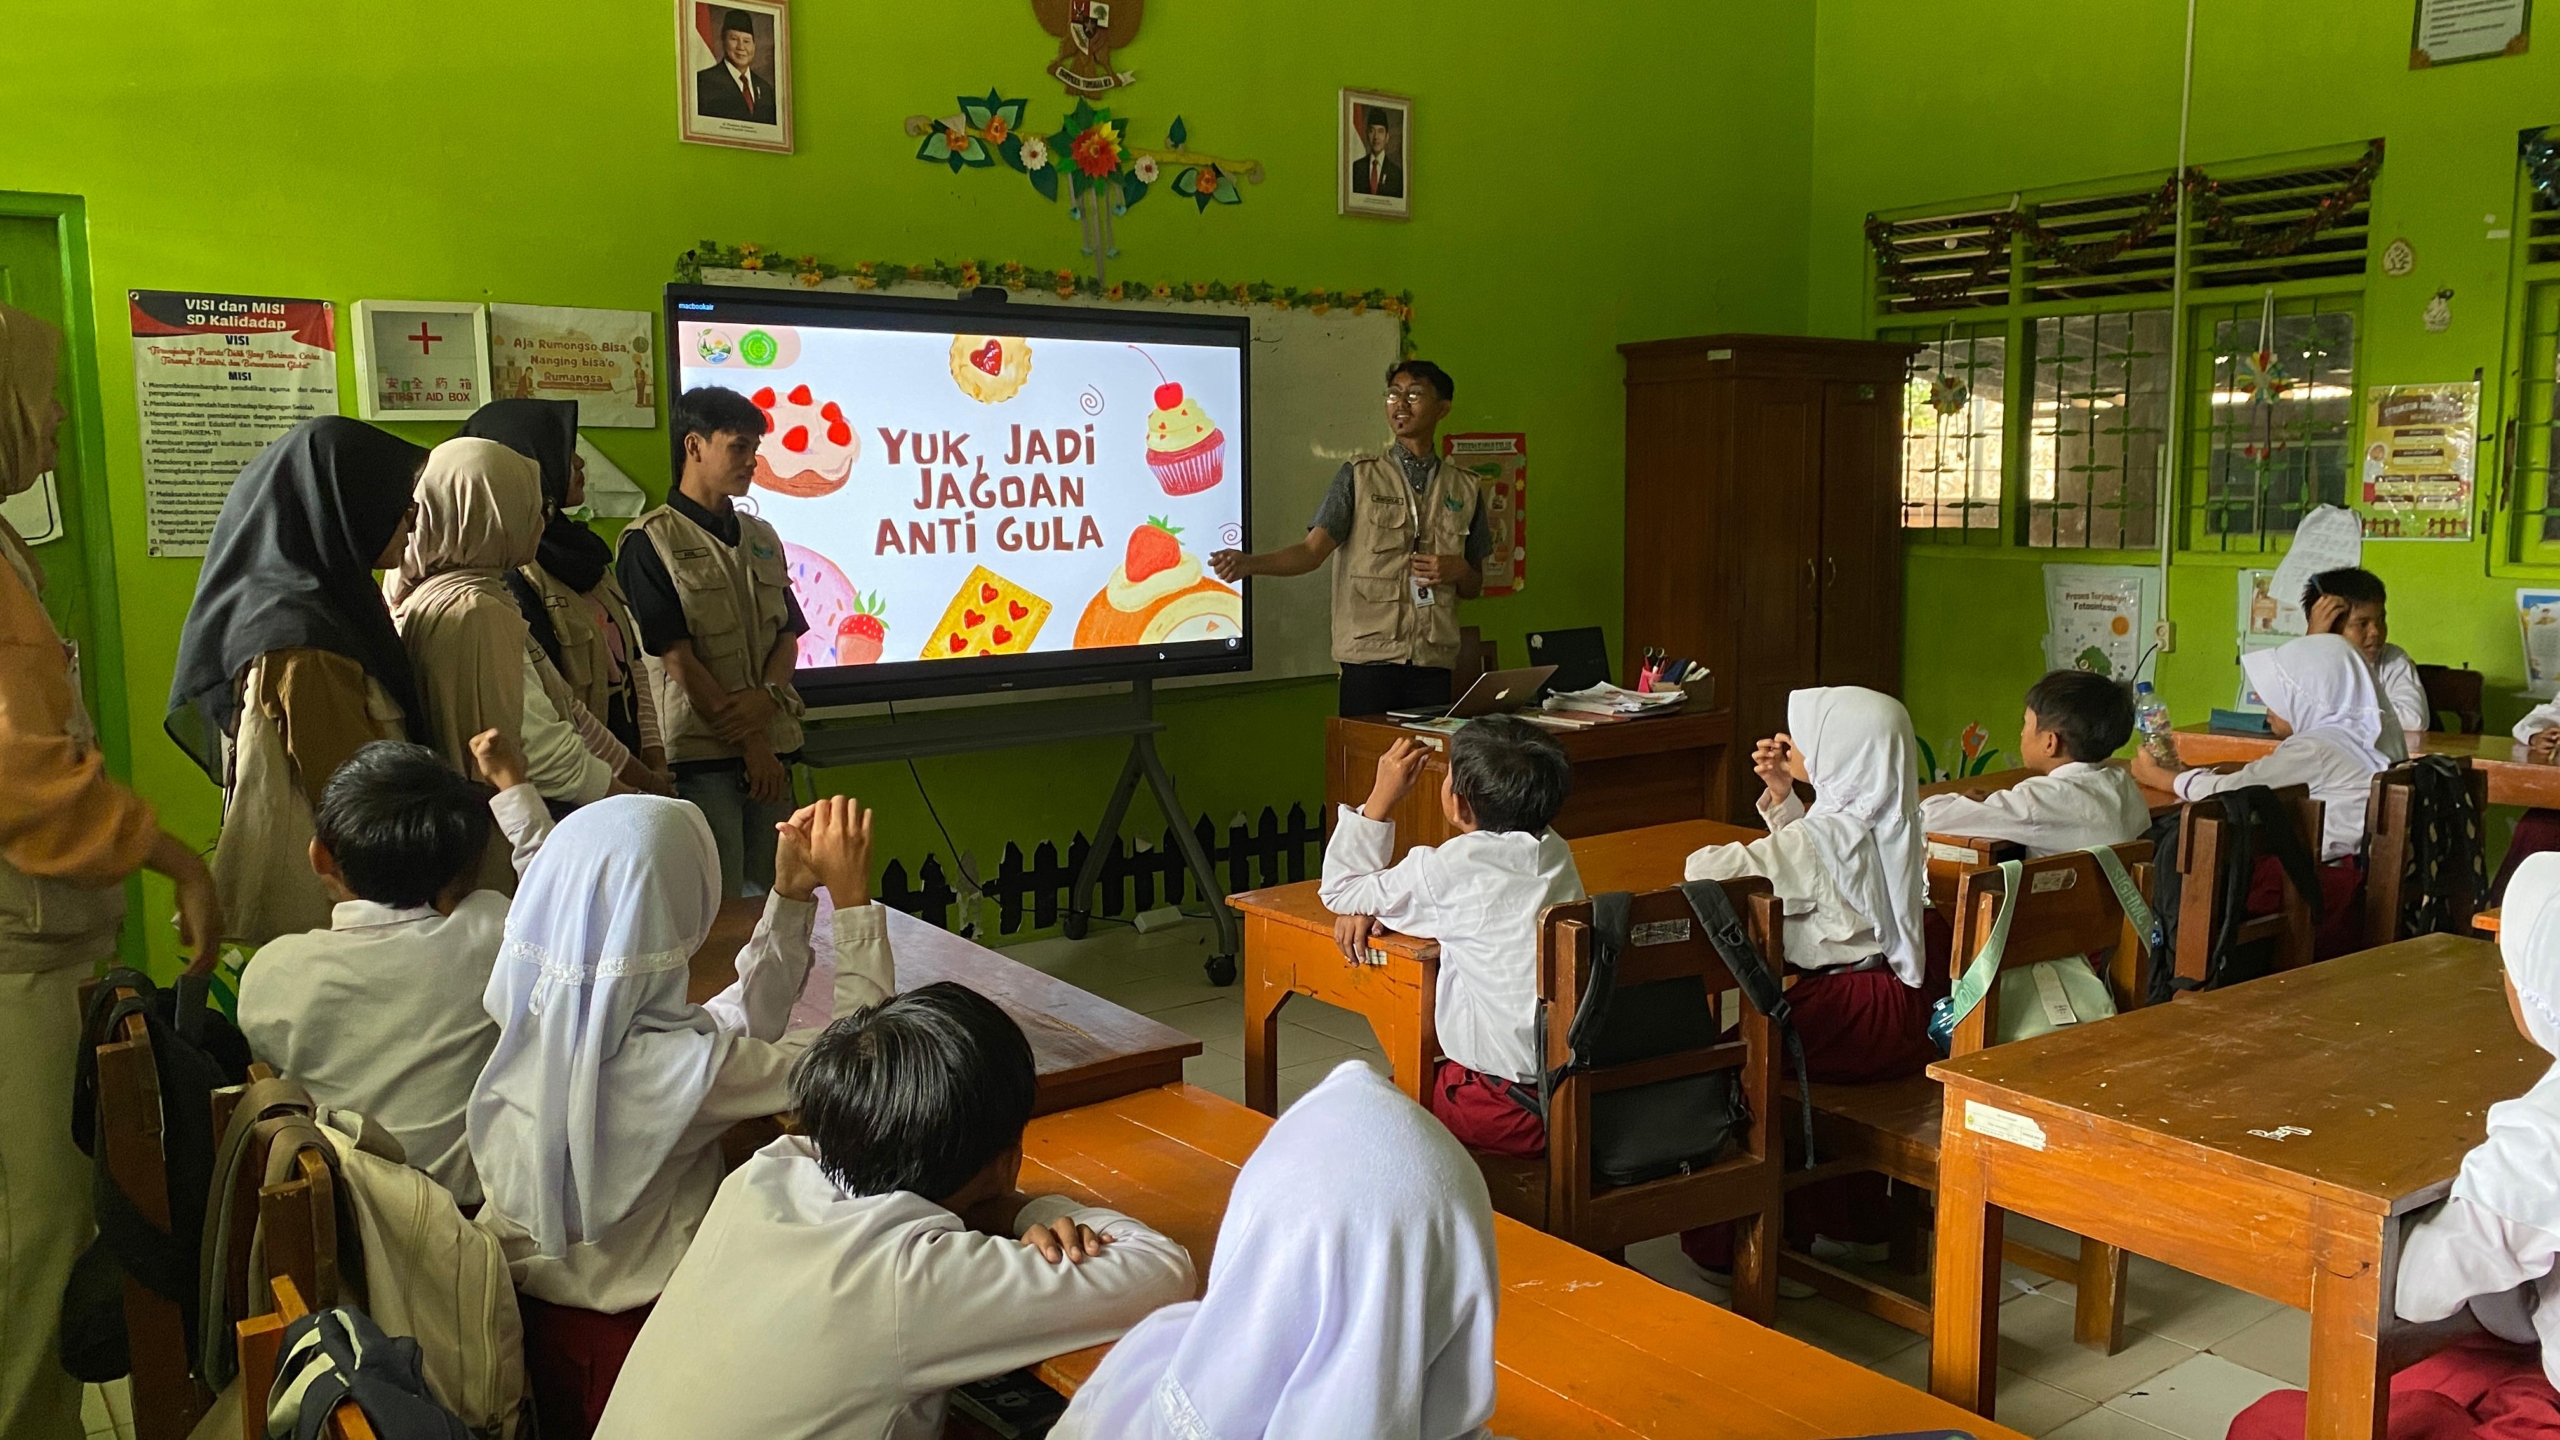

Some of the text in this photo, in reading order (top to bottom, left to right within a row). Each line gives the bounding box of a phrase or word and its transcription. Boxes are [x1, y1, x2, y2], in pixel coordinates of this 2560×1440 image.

[184, 298, 285, 315] VISI dan MISI
[186, 314, 287, 331] SD Kalidadap
[225, 334, 250, 346] VISI
[513, 338, 534, 350] Aja
[538, 339, 598, 352] Rumongso
[530, 354, 615, 368] Nanging bisa'o
[228, 371, 252, 381] MISI
[544, 371, 604, 384] Rumangsa
[387, 392, 471, 402] FIRST AID BOX
[877, 427, 984, 474] YUK,
[913, 466, 1084, 510] JAGOAN
[996, 514, 1104, 552] GULA
